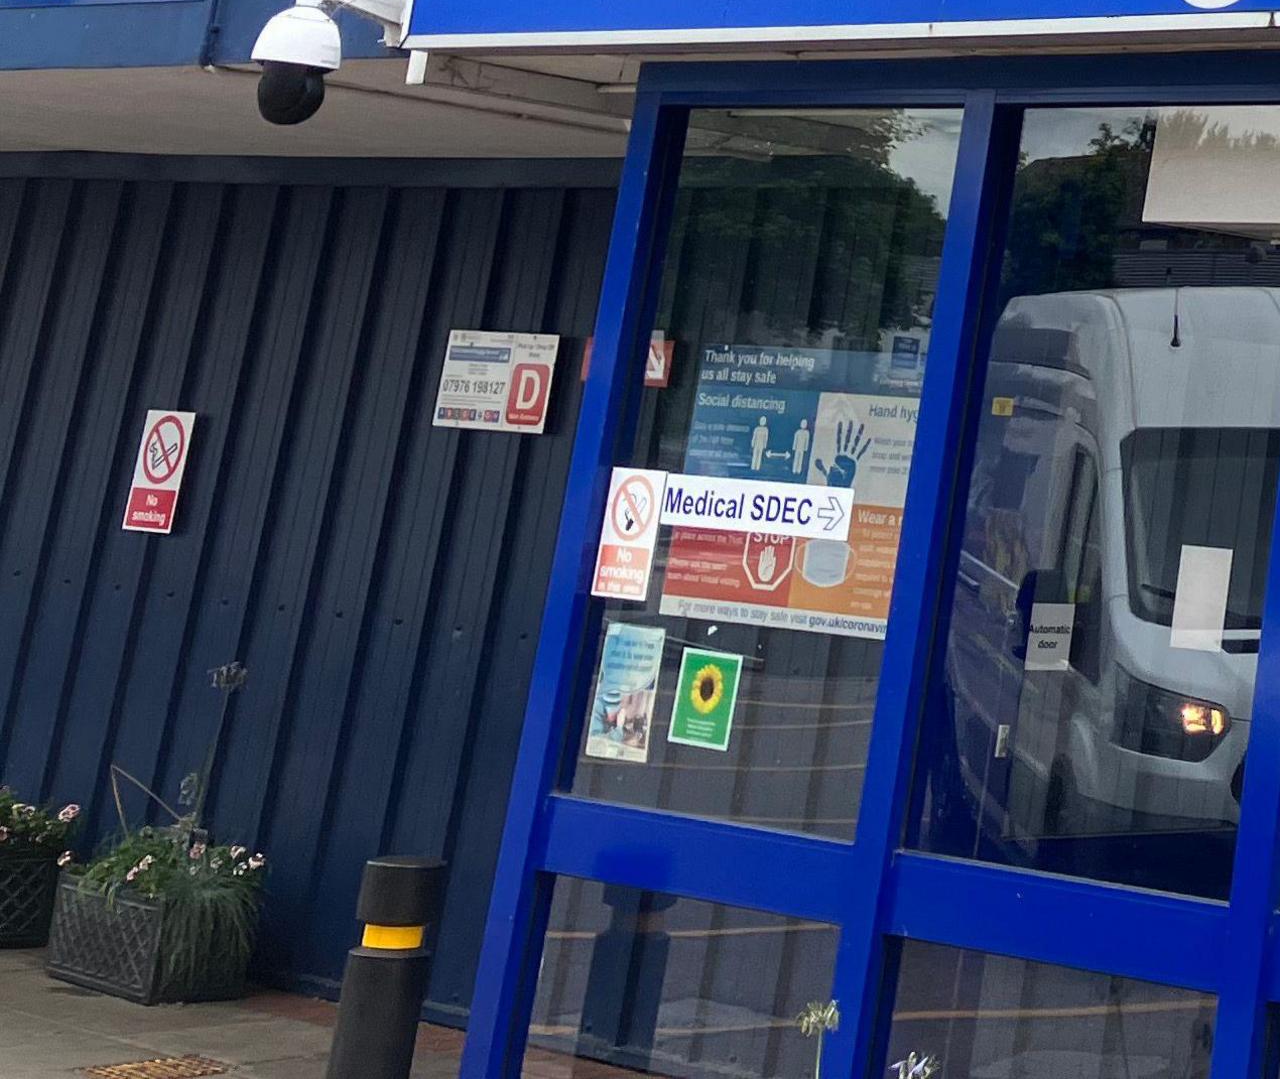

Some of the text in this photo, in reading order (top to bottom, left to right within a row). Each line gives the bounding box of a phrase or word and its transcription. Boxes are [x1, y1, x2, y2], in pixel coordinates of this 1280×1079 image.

[705, 349, 815, 371] Thank you for helping
[701, 369, 777, 385] us all stay safe
[516, 369, 541, 410] D
[699, 393, 786, 414] Social distancing
[869, 405, 897, 418] Hand
[146, 494, 159, 507] No
[664, 487, 813, 525] Medical SDEC
[132, 510, 166, 527] smoking
[859, 509, 888, 525] Wear
[616, 547, 632, 563] No
[600, 566, 644, 584] smoking
[678, 600, 692, 612] For
[693, 603, 716, 614] more
[717, 605, 739, 620] ways
[740, 607, 749, 617] to
[750, 610, 768, 623] stay
[770, 611, 789, 624] safe
[1030, 624, 1071, 634] Automatic
[1038, 639, 1058, 649] door
